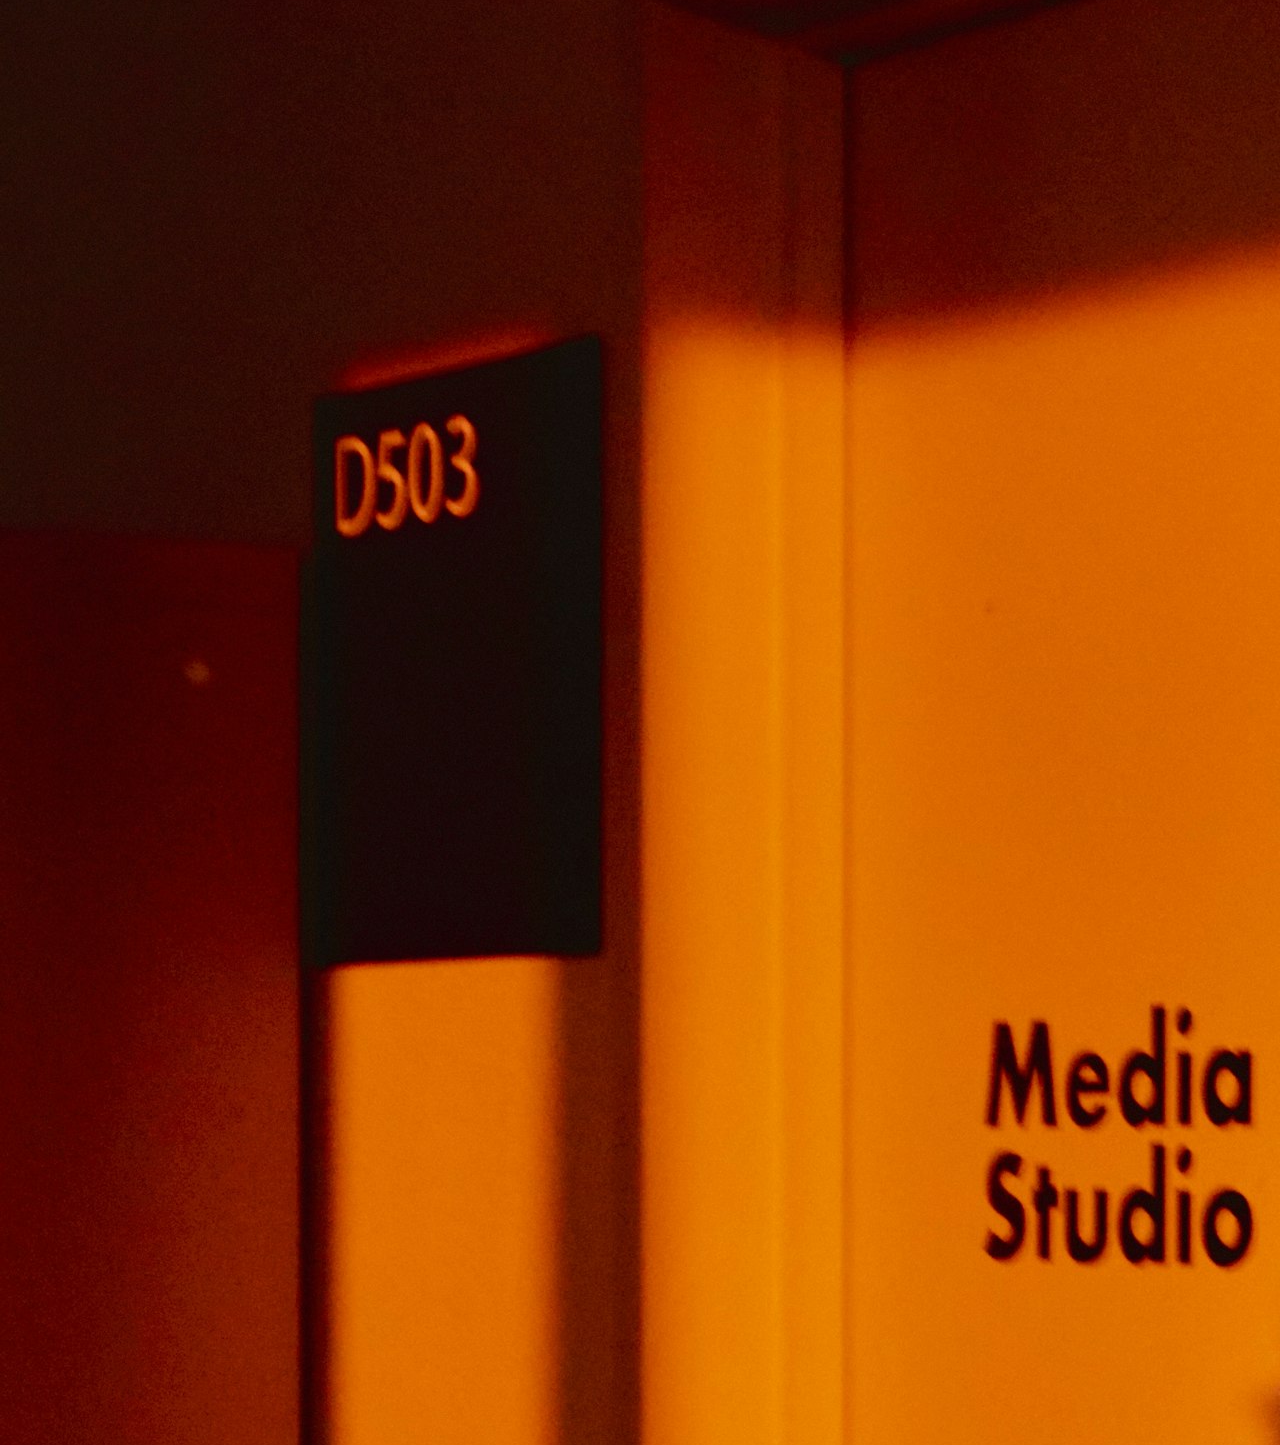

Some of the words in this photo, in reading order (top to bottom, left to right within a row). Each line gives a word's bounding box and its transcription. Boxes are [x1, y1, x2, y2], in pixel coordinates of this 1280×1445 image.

[334, 414, 481, 538] D503
[985, 1004, 1253, 1129] Media
[983, 1143, 1253, 1267] Studio
